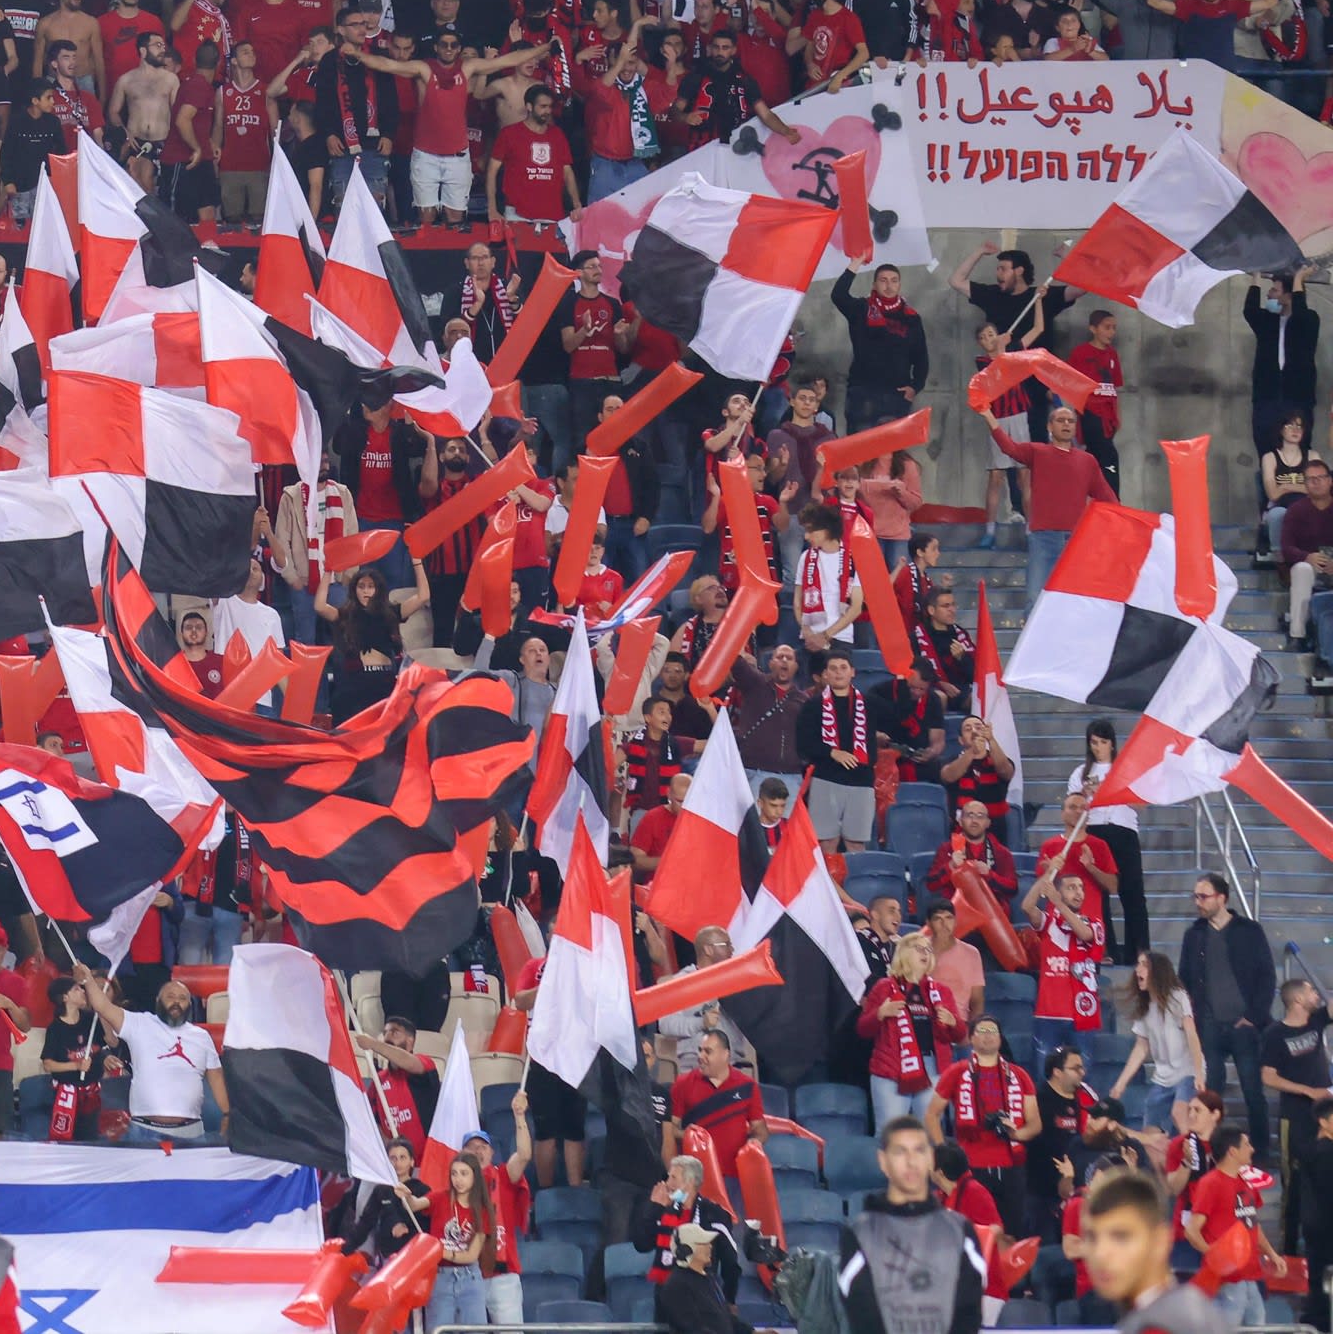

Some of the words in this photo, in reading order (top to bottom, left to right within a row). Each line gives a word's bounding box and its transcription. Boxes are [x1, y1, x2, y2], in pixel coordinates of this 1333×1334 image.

[234, 96, 252, 112] 23
[1133, 68, 1194, 132] يلا
[1077, 143, 1158, 183] ללה
[822, 696, 837, 750] 2021
[853, 696, 869, 754] 2000
